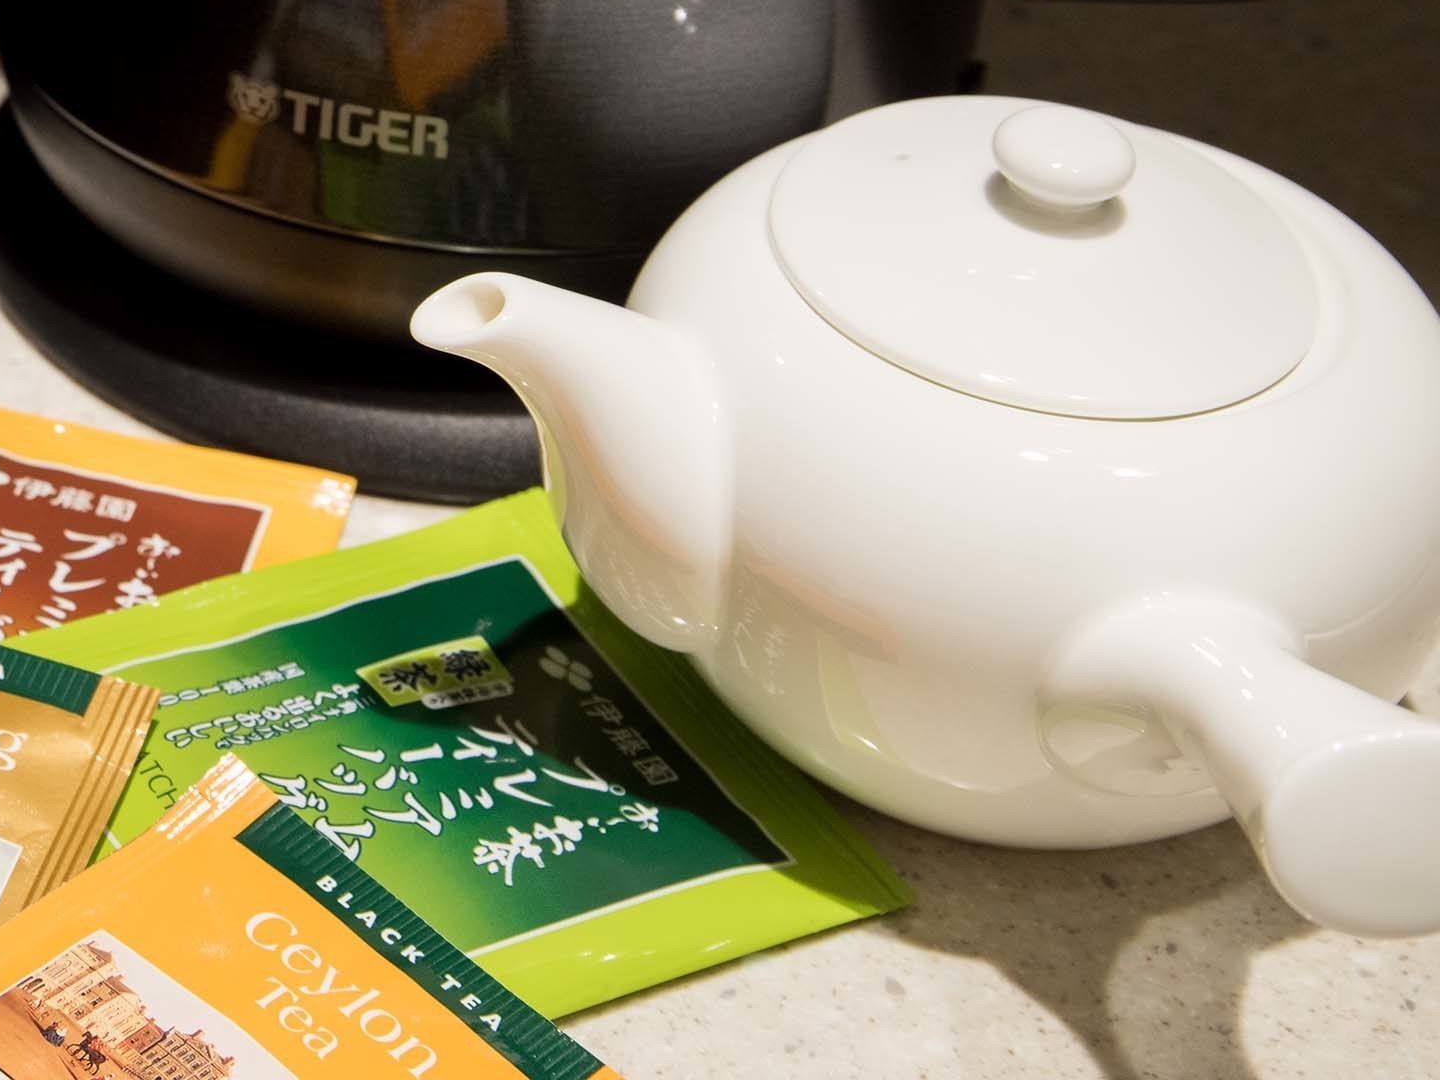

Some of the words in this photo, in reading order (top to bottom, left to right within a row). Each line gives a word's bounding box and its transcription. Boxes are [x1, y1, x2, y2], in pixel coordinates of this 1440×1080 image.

[283, 89, 449, 160] TIGER
[164, 683, 361, 749] よく出るおいしい
[258, 714, 539, 812] ティーバッグ
[578, 694, 680, 786] 伊藤園
[313, 755, 627, 861] プレミアム
[244, 911, 440, 1080] Ceylon
[315, 874, 427, 965] BLACK
[439, 973, 504, 1033] TEA
[255, 977, 341, 1060] Tea
